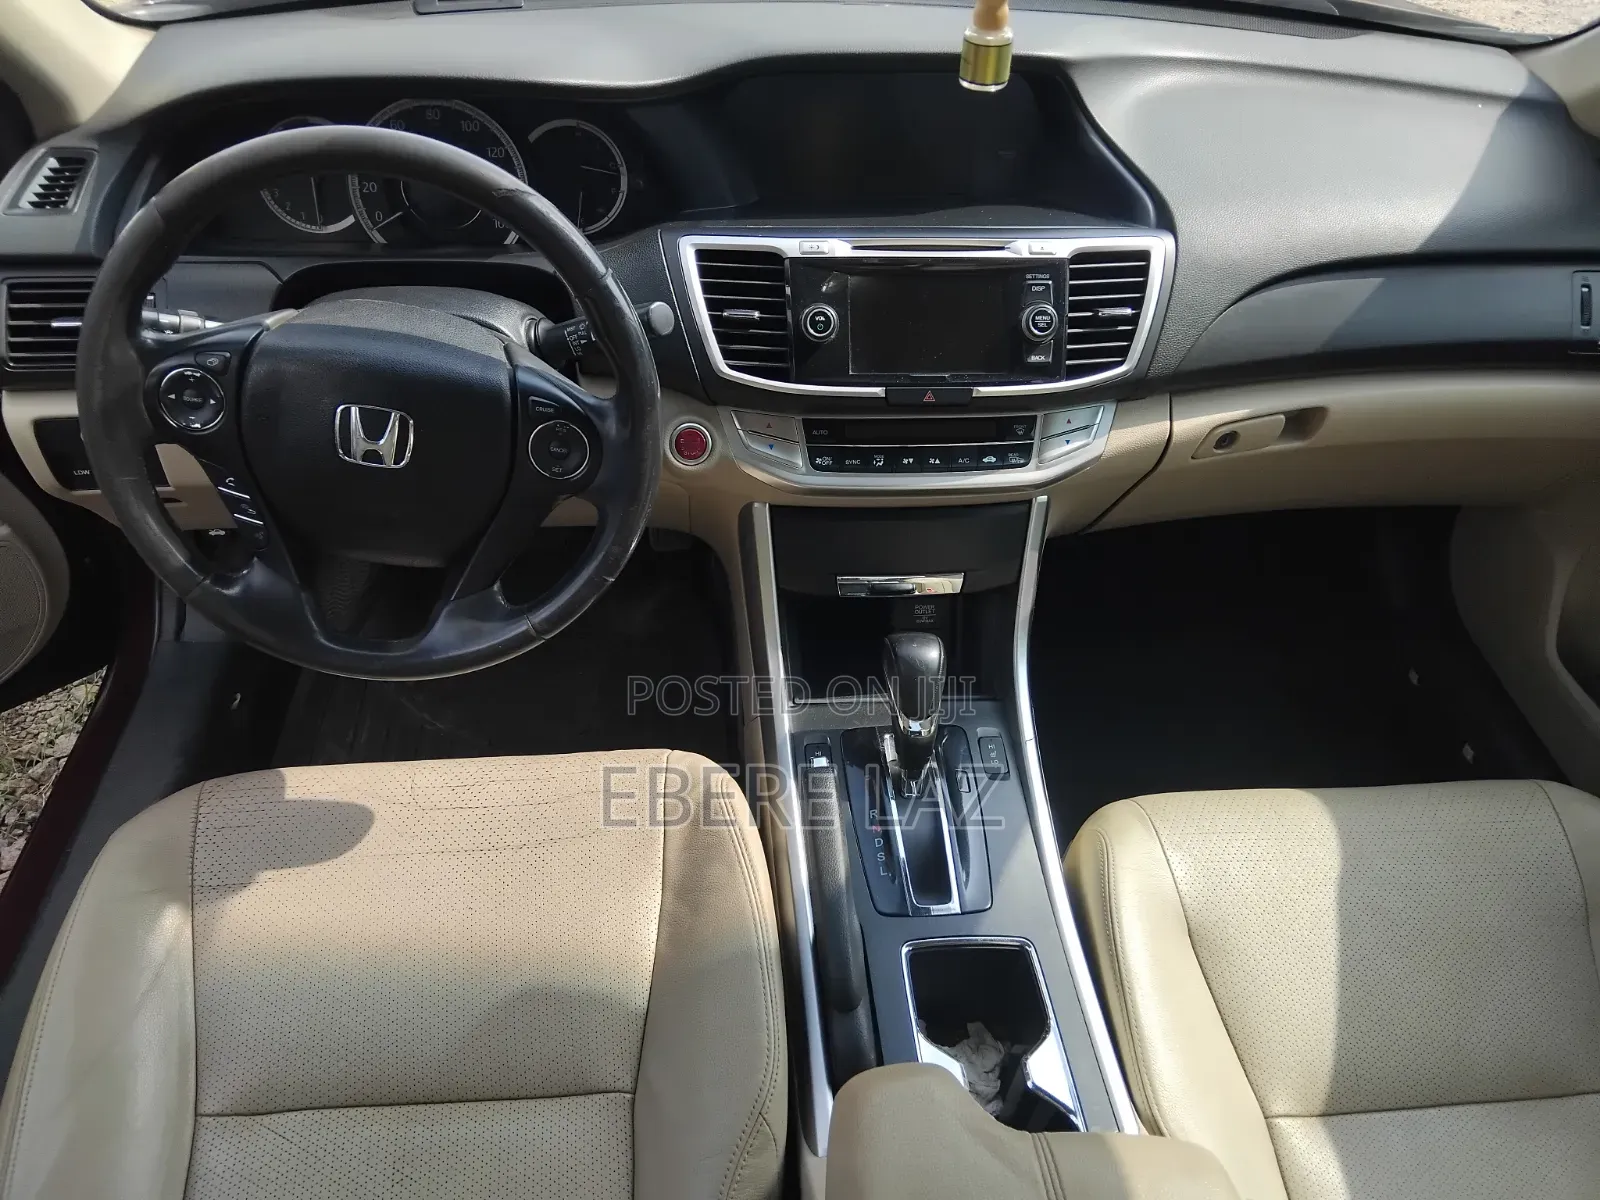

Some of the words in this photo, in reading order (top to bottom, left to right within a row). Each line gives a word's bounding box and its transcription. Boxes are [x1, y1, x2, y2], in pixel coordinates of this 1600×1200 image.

[425, 108, 440, 120] 80
[460, 120, 480, 132] 100
[486, 146, 505, 158] 120
[362, 181, 377, 193] 20
[285, 201, 291, 211] 2
[375, 210, 383, 222] 0
[535, 406, 555, 414] CRUISE
[869, 808, 878, 819] R
[874, 837, 884, 848] D
[877, 851, 886, 862] S
